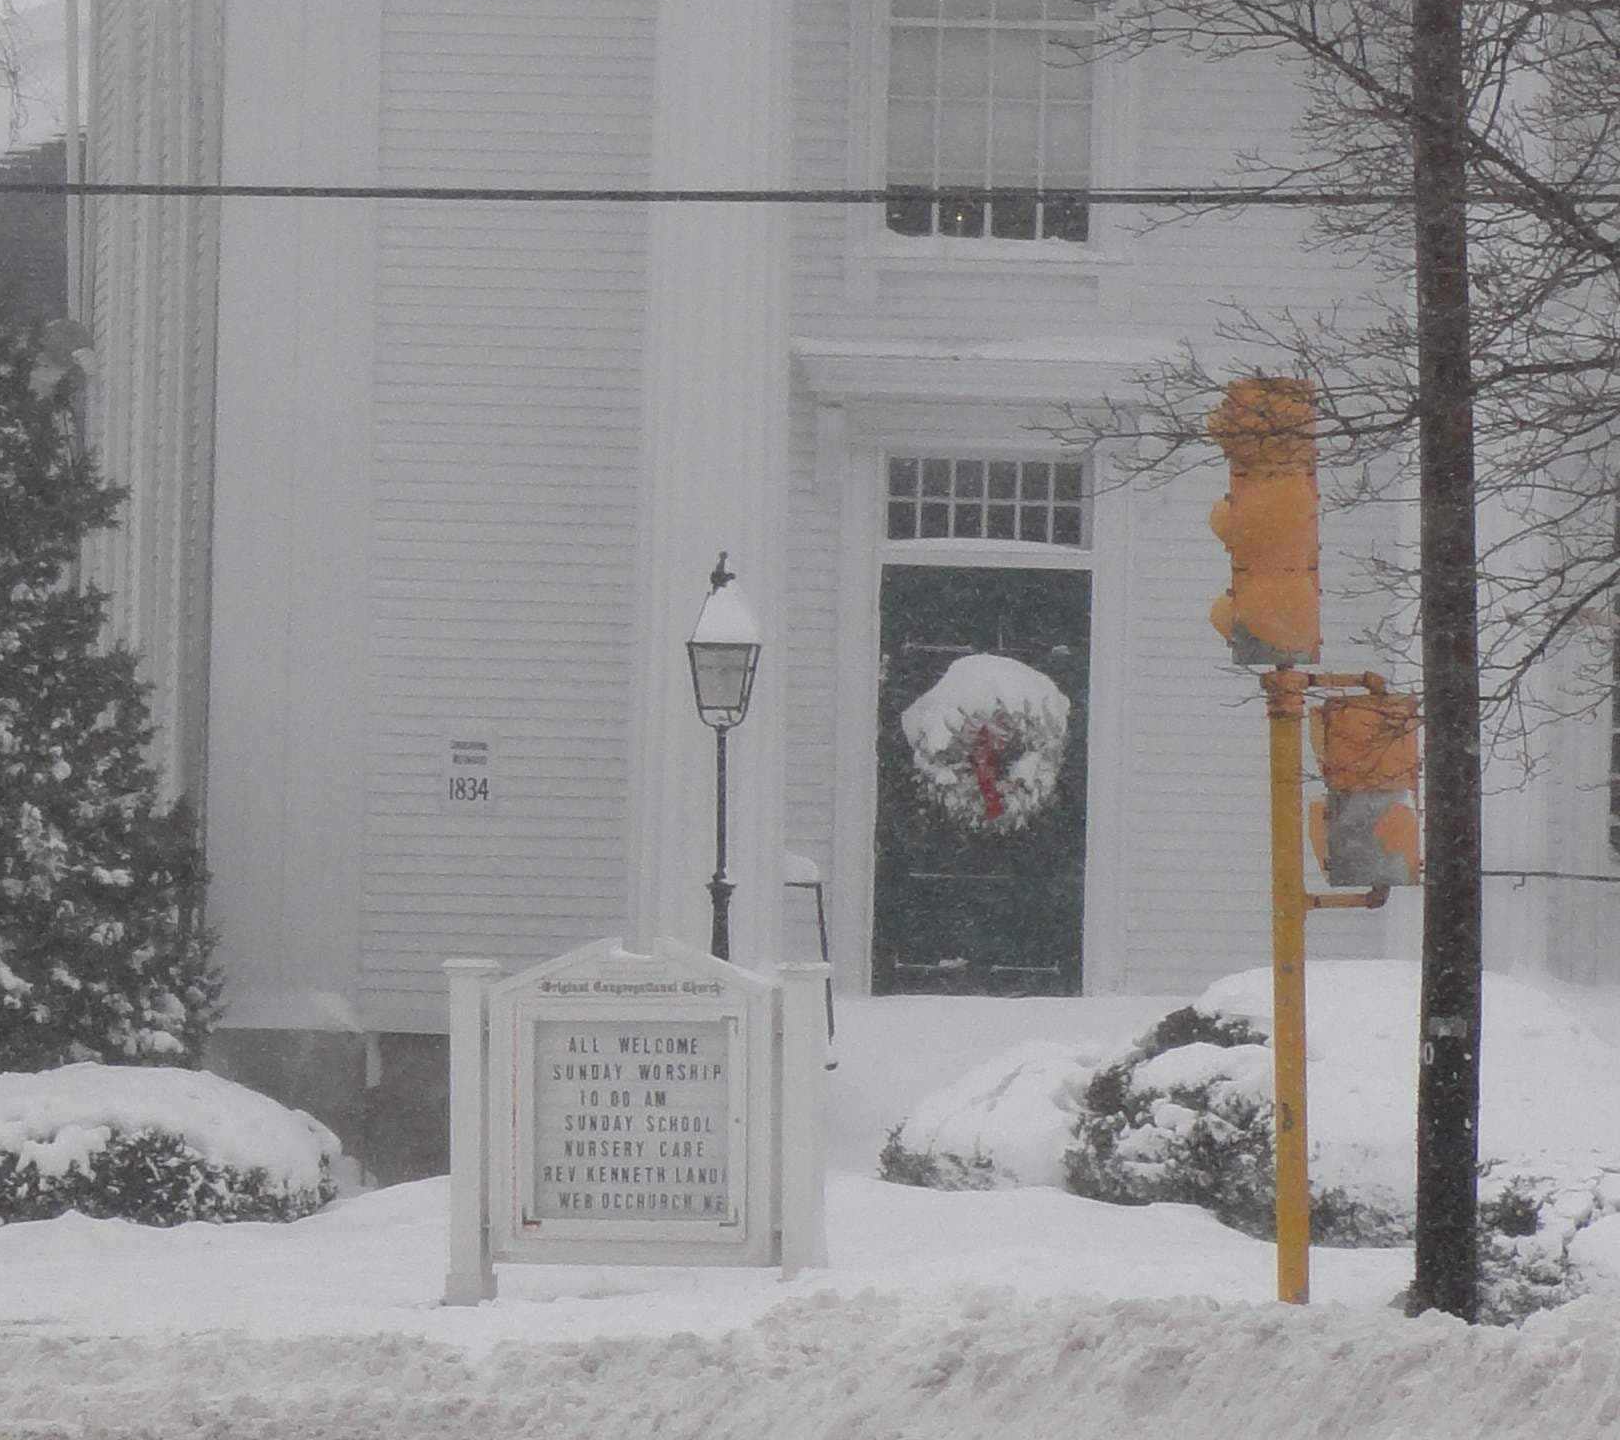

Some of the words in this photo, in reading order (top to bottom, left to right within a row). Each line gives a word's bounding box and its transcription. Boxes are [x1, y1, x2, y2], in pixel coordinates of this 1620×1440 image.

[449, 777, 489, 801] 1834
[569, 1037, 600, 1054] ALL
[618, 1037, 698, 1055] WELCOME
[553, 1064, 623, 1081] SUNDAY
[638, 1064, 722, 1081] WORSHIP
[645, 1090, 668, 1107] AM
[564, 1115, 633, 1132] SUNDAY
[646, 1115, 712, 1133] SCHOOL
[564, 1140, 644, 1158] NURSERY
[659, 1141, 705, 1158] CARE
[543, 1166, 576, 1182] REV
[586, 1166, 666, 1184] KENNETH
[559, 1192, 593, 1209] WEB
